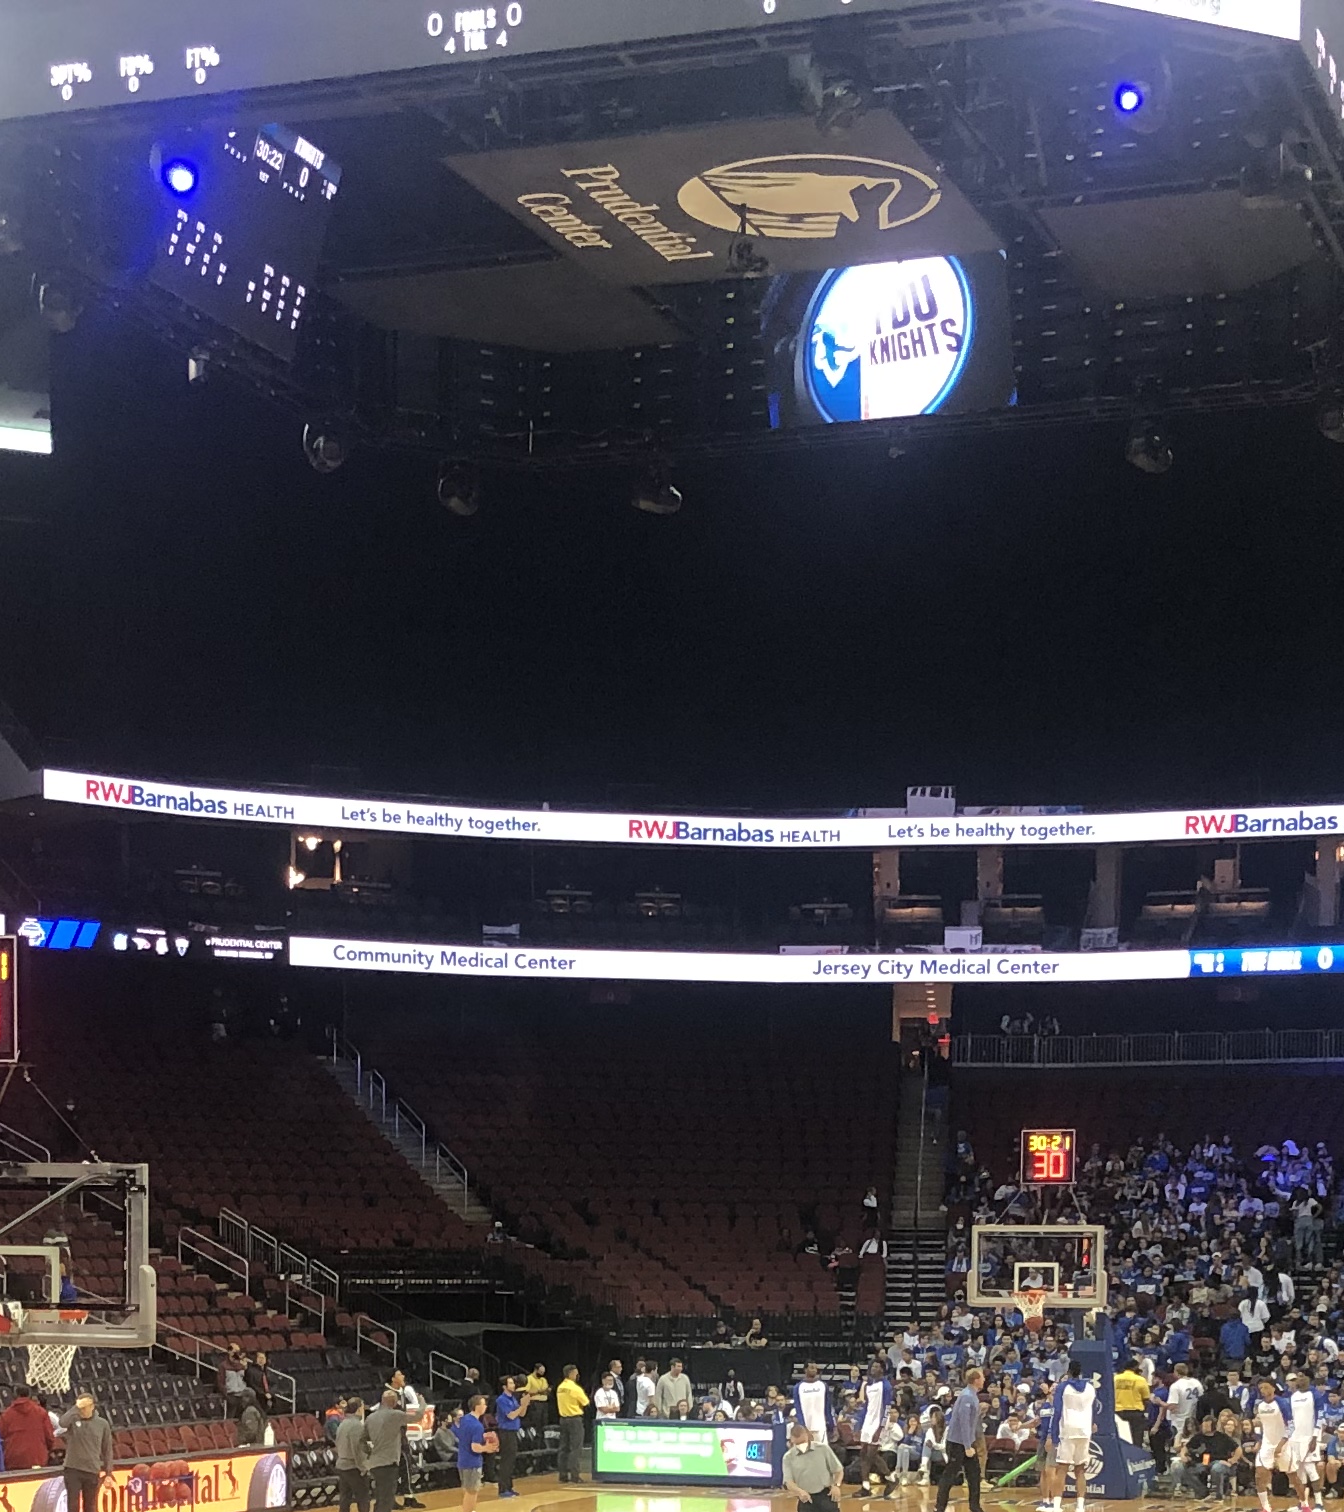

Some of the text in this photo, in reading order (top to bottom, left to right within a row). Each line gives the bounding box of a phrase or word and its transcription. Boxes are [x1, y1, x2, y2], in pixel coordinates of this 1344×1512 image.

[256, 139, 284, 171] 30:22
[517, 192, 613, 249] Center
[559, 163, 714, 262] Prudential
[868, 318, 964, 366] KNIGHTS
[233, 802, 295, 820] HEALTH
[341, 805, 541, 835] Let's be healthy together.
[779, 829, 841, 843] HEALTH
[887, 821, 1096, 842] Let's be healthy together.
[332, 944, 577, 971] Community Medical Center
[812, 958, 1060, 980] Jersey City Medical Center
[1028, 1134, 1071, 1152] 30:21
[1033, 1152, 1065, 1179] 30
[1185, 1387, 1199, 1401] 24
